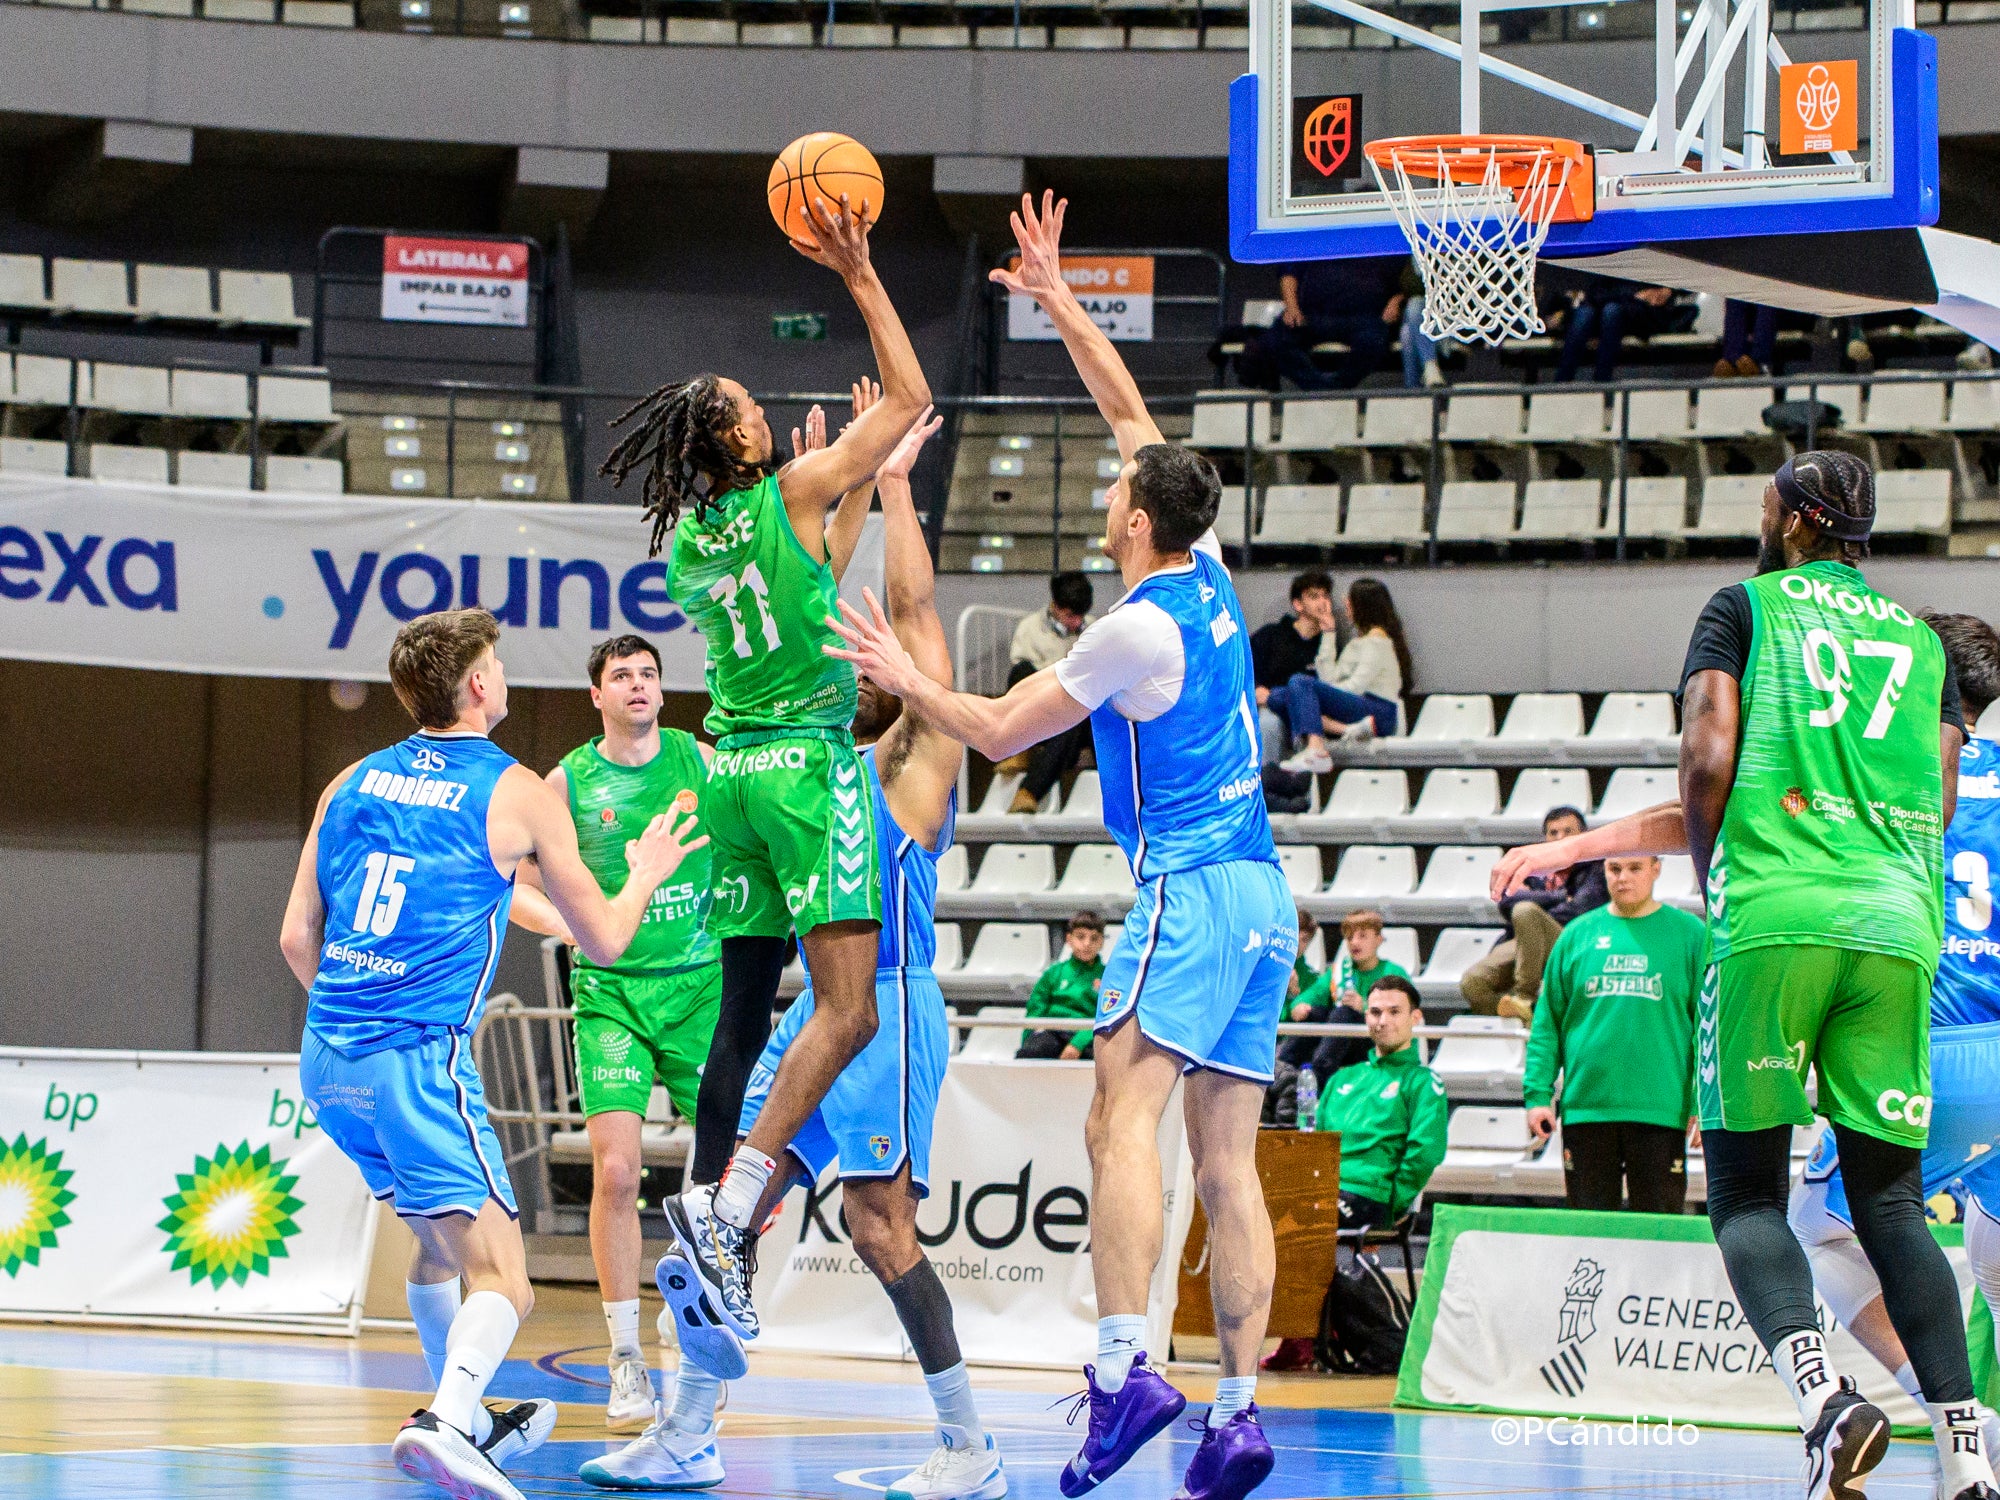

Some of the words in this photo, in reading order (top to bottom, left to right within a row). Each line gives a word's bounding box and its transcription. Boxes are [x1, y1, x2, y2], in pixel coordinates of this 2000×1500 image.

[1332, 103, 1348, 111] FEB
[1804, 140, 1832, 150] FEB
[399, 249, 493, 270] LATERAL
[497, 254, 514, 271] A
[1114, 268, 1130, 287] C
[400, 279, 457, 295] IMPAR
[462, 283, 511, 299] BAJO
[0, 524, 178, 614] exa
[312, 549, 700, 650] youne
[1780, 575, 1915, 627] OKOUO
[1803, 628, 1913, 740] 97
[1238, 690, 1259, 768] 1
[411, 748, 449, 772] as
[358, 768, 469, 812] RODRÍGUEZ
[1889, 806, 1939, 824] Diputació
[1889, 819, 1902, 829] de
[1903, 820, 1942, 837] Castelló
[352, 851, 416, 937] 15
[641, 893, 700, 924] STELLÓ
[649, 882, 695, 906] MICS
[1952, 850, 1992, 932] 3
[325, 941, 408, 977] telepizza
[1602, 953, 1648, 973] AMICS
[592, 1065, 642, 1083] ibertic
[44, 1082, 98, 1132] bp
[268, 1088, 320, 1139] bp
[799, 1158, 1092, 1254] Kude
[1614, 1337, 1778, 1374] VALENCIA
